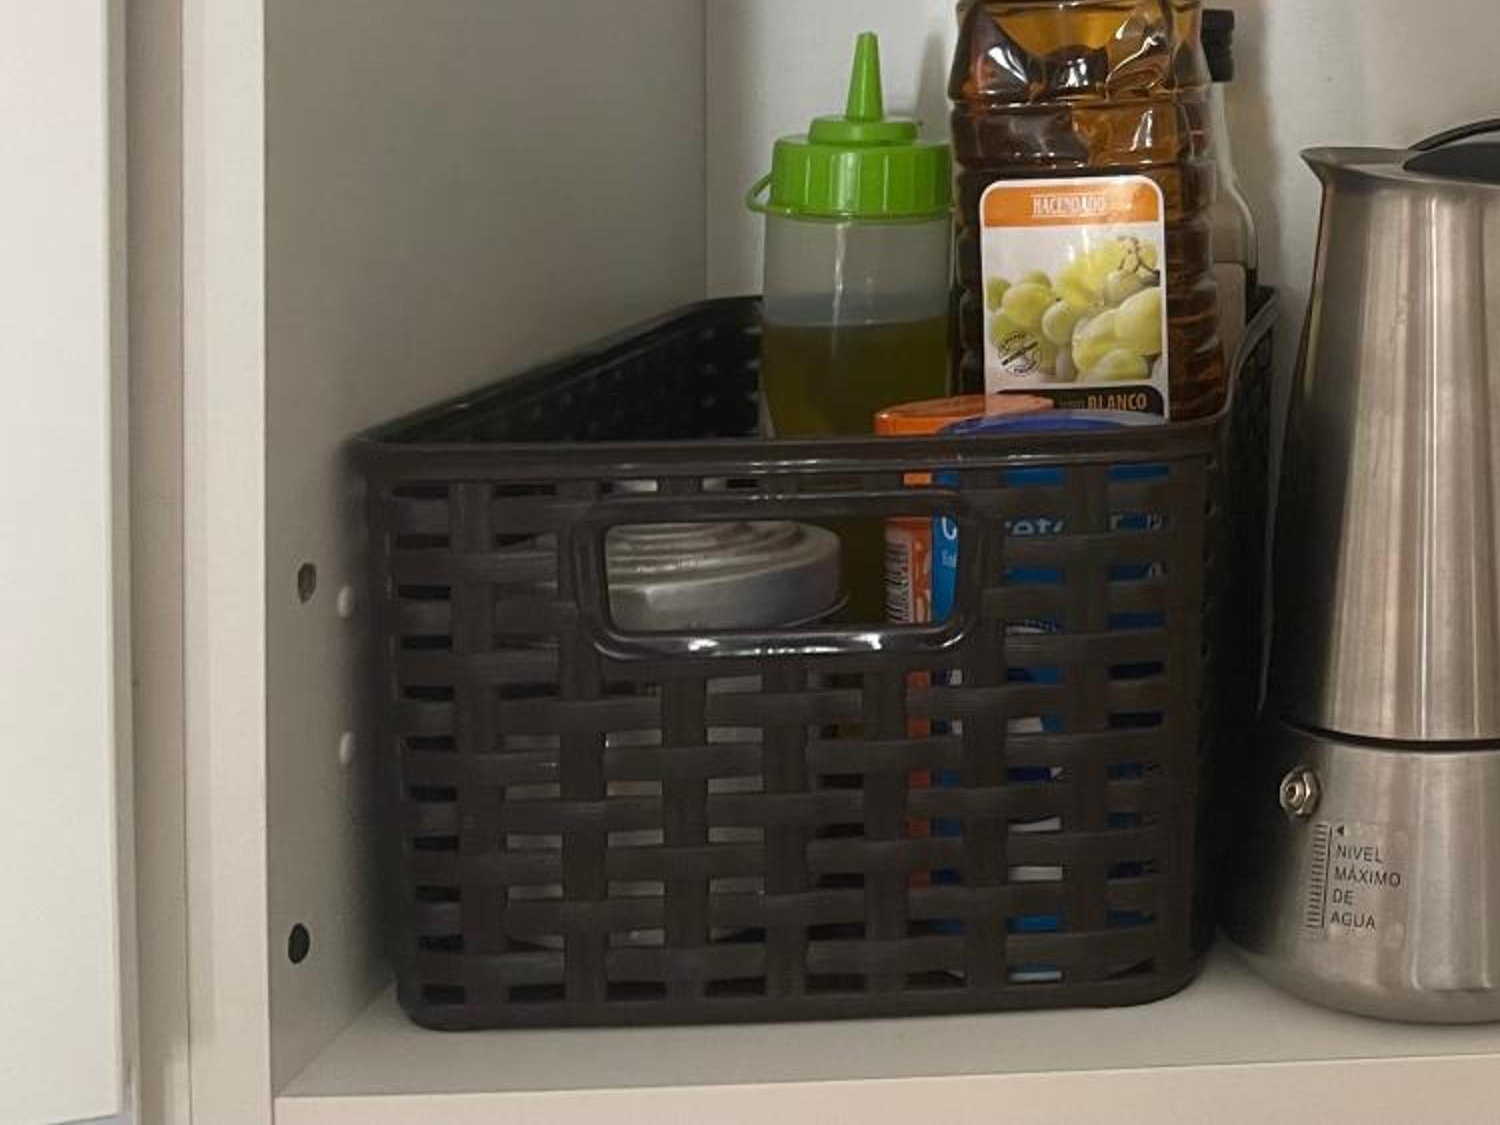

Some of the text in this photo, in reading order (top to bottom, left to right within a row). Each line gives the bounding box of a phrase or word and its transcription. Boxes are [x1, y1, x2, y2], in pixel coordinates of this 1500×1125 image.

[1337, 844, 1383, 863] NIVEL
[1332, 888, 1354, 905] DE
[1330, 911, 1376, 928] AGUA
